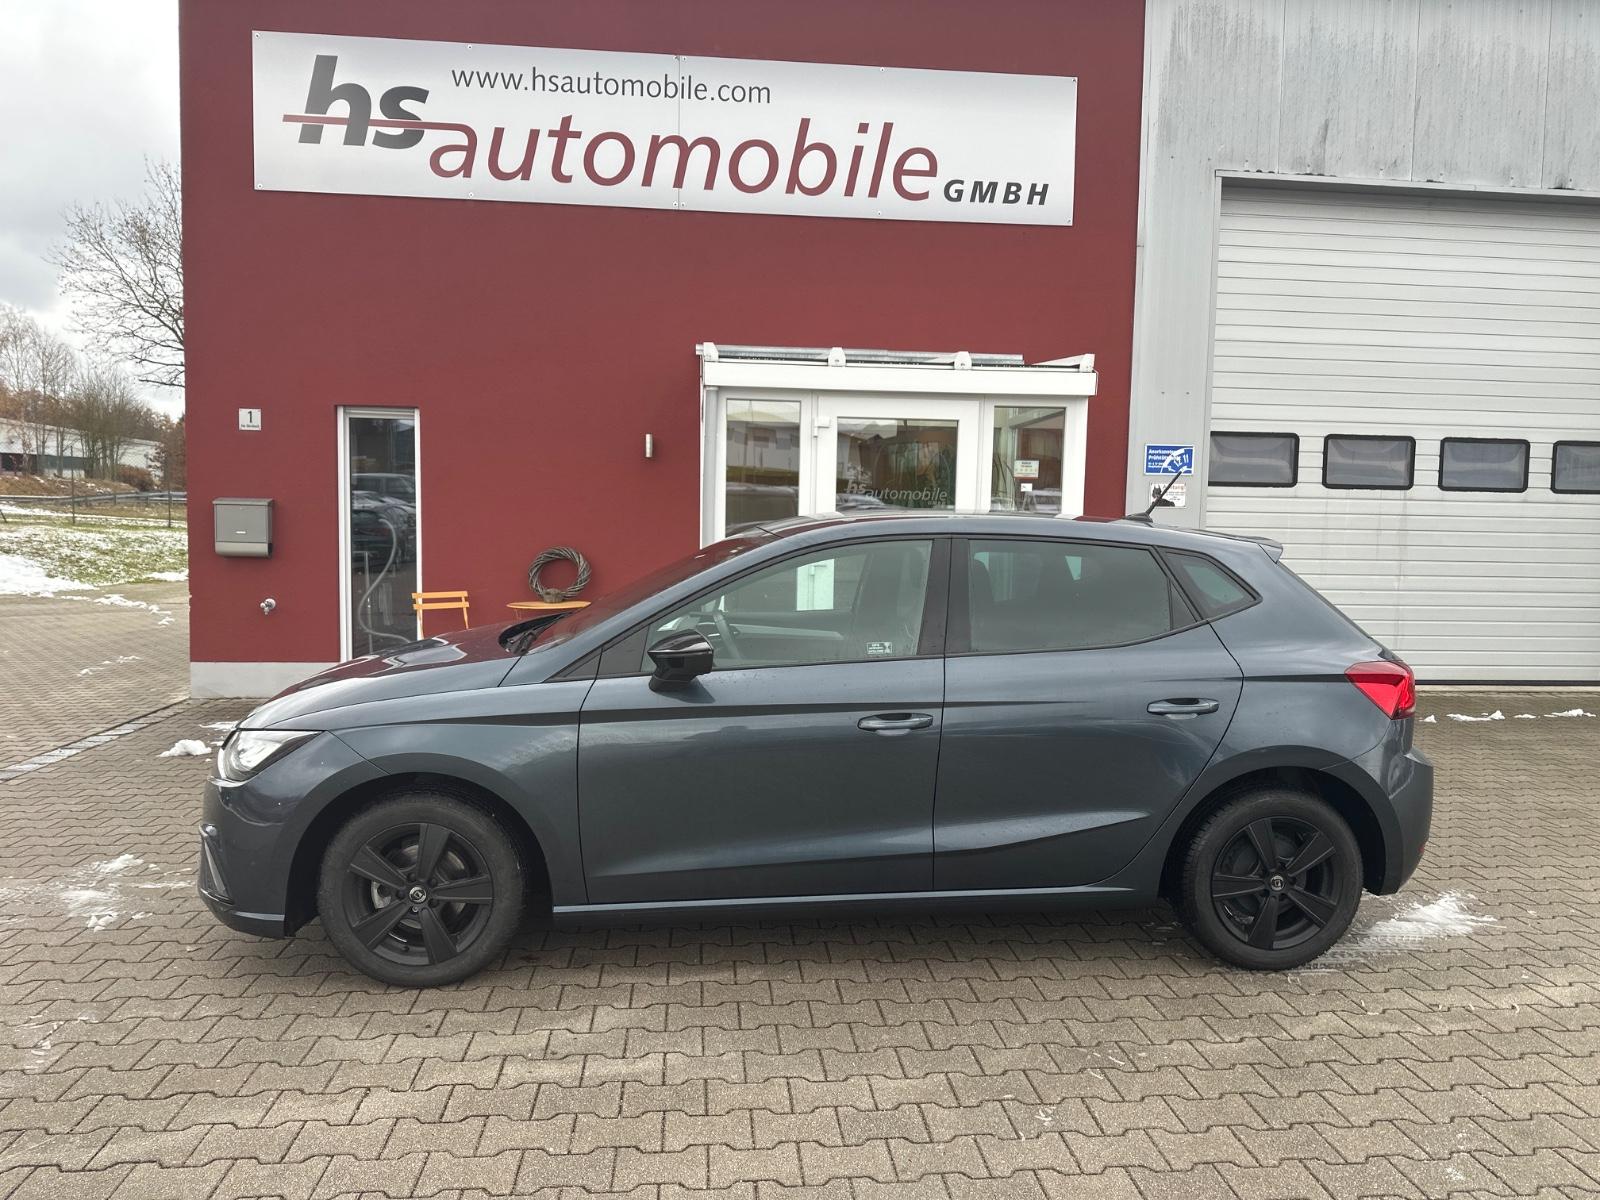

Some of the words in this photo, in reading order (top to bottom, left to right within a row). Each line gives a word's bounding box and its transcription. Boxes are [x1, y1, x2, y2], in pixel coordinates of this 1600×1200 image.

[451, 66, 771, 104] www.hsautomobile.com
[298, 54, 430, 150] hs
[429, 117, 938, 202] automobile
[943, 179, 1049, 206] GMBH
[247, 410, 253, 424] 1
[865, 488, 948, 502] automobile
